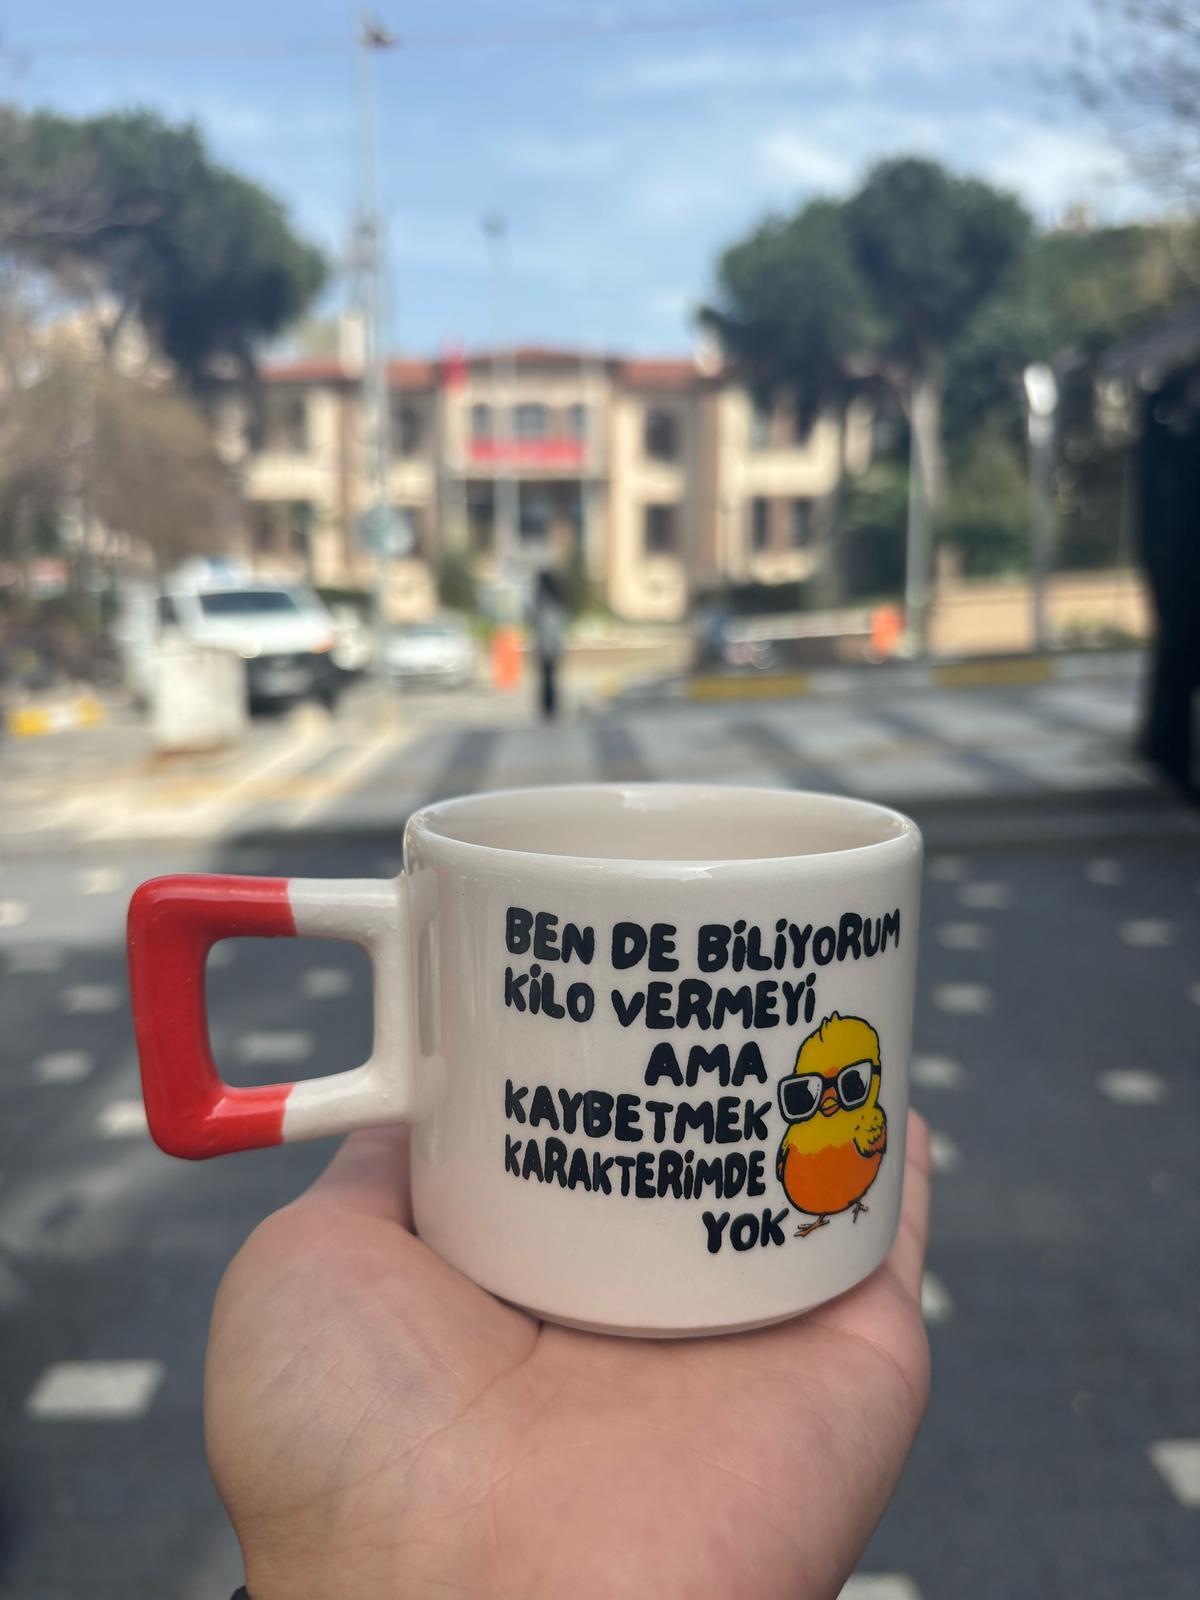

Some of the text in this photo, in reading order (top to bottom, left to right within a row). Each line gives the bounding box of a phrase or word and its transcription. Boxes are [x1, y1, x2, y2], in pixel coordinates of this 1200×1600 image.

[504, 906, 596, 966] BEN
[610, 921, 680, 973] DE
[644, 1040, 769, 1088] AMA
[504, 1078, 773, 1145] KAYBETMEK
[701, 1207, 790, 1255] YOK
